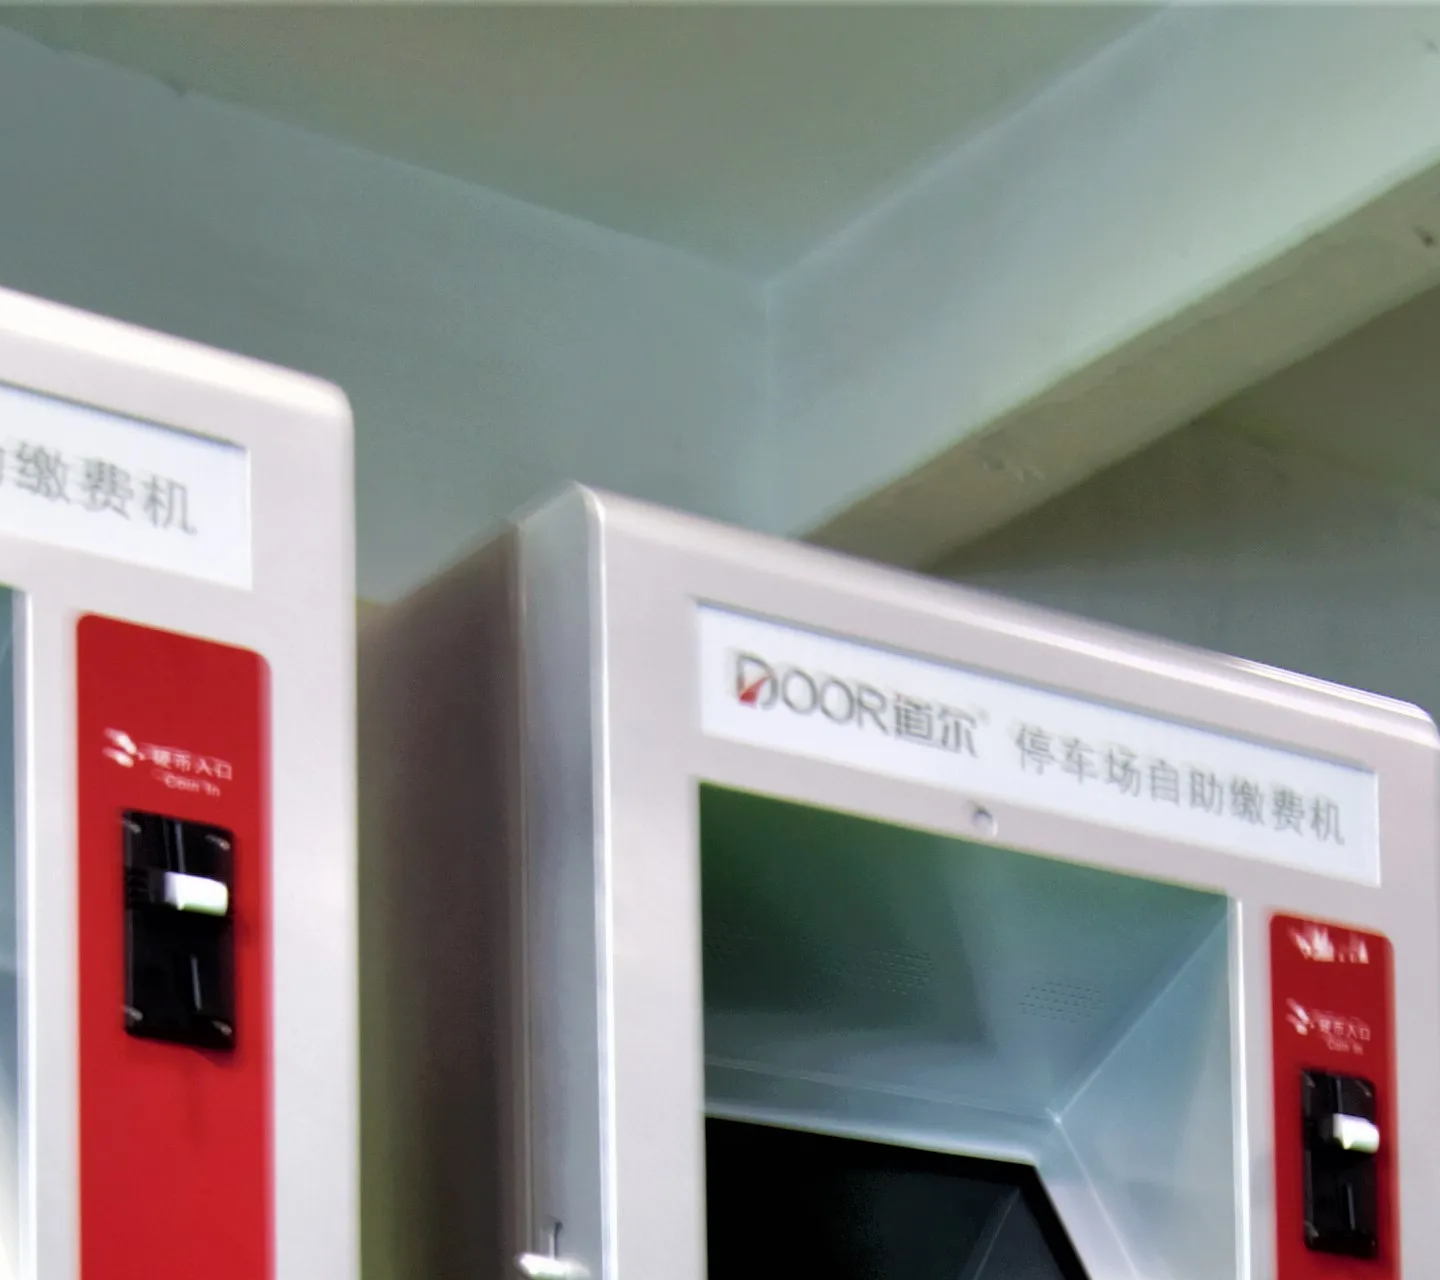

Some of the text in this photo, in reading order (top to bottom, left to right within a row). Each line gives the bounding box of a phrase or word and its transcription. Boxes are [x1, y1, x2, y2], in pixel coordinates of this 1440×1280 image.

[1015, 721, 1347, 847] 停车场自助缴费机
